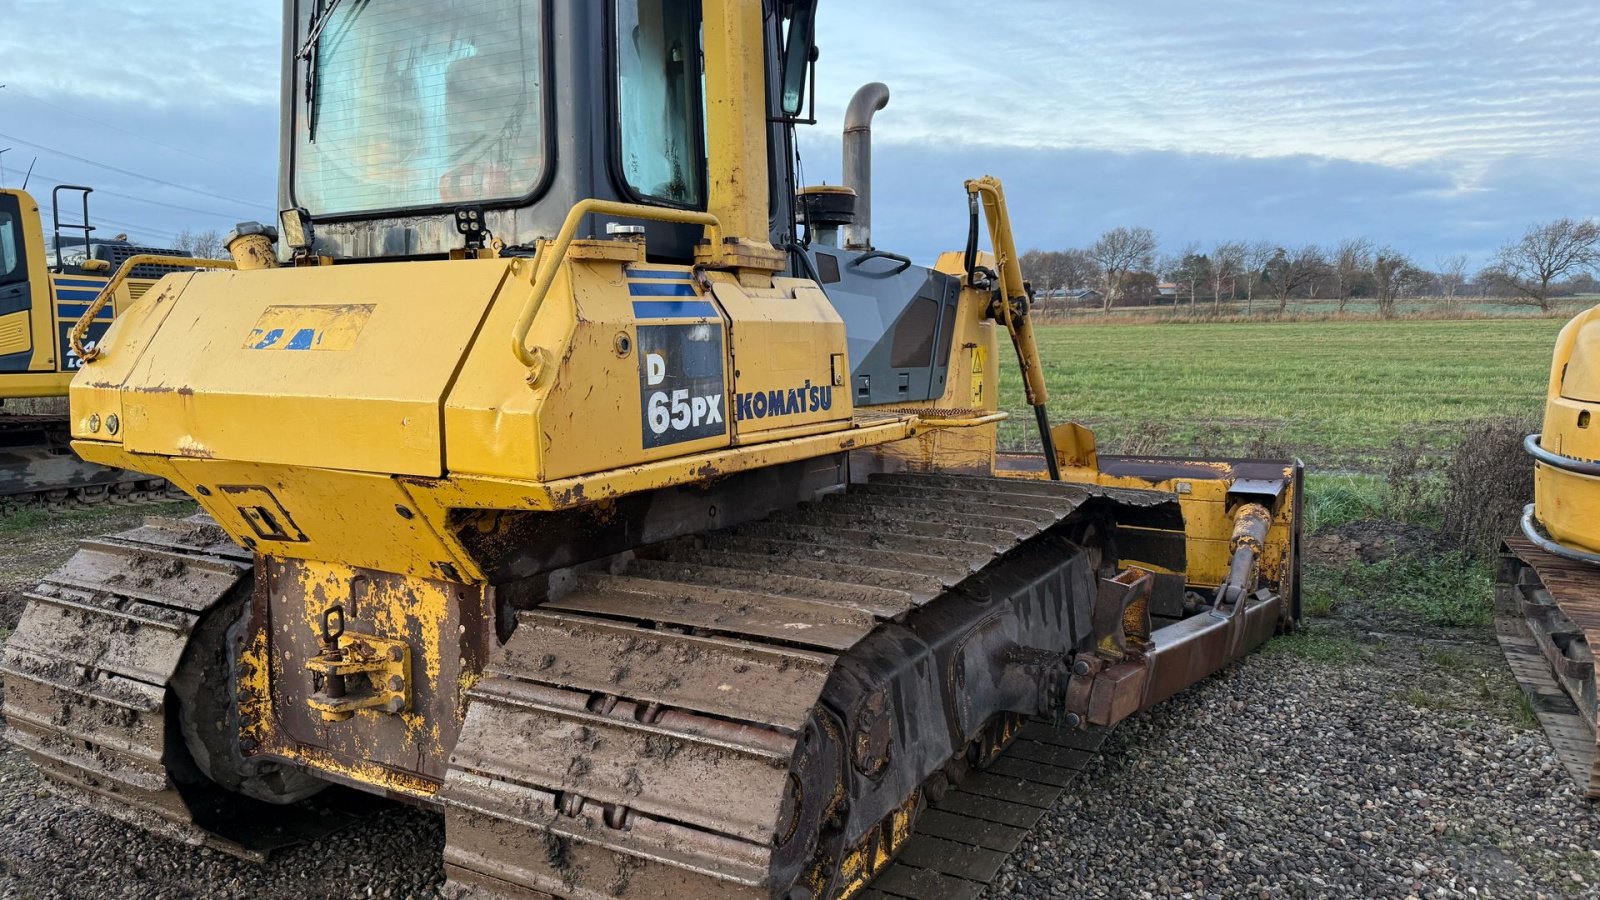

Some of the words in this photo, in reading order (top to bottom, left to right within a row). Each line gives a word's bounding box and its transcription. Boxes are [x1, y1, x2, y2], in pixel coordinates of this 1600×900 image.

[647, 353, 666, 386] D
[648, 388, 723, 434] 65PX
[736, 379, 832, 421] KOMATSU
